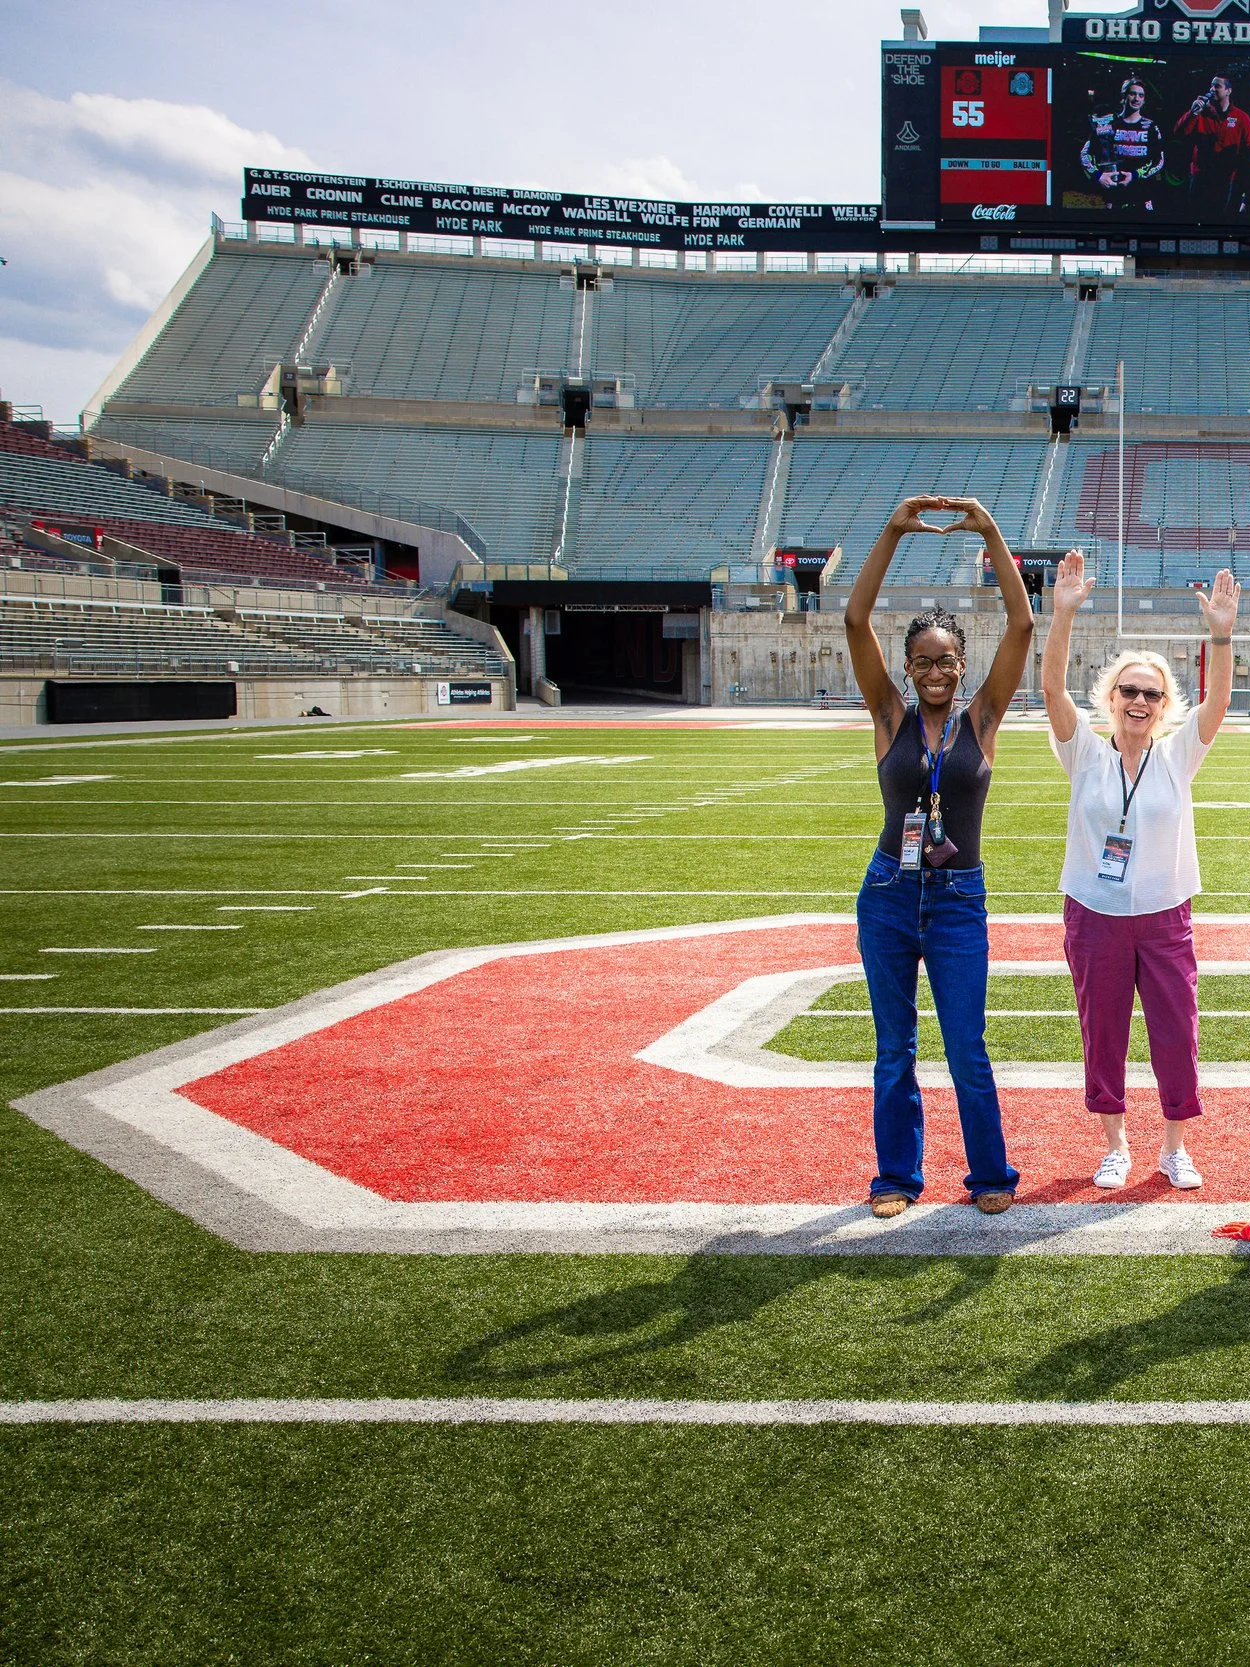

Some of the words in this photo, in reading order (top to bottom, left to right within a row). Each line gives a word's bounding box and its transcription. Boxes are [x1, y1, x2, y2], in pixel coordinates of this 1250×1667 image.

[1085, 18, 1161, 42] OHIO
[884, 53, 932, 66] DEFEND
[974, 51, 1017, 67] meijer
[896, 64, 920, 75] THE
[890, 74, 925, 85] 'SHOE
[952, 101, 984, 127] 55
[948, 160, 969, 168] DOWN
[981, 160, 989, 168] TO
[1013, 161, 1029, 169] BALL
[250, 169, 262, 178] G.
[263, 171, 271, 179] &
[272, 172, 282, 180] T.
[283, 172, 367, 187] SCHOTTENSTEIN
[250, 183, 292, 198] AUER
[306, 188, 363, 204] CRONIN
[473, 186, 509, 198] DESHE,
[513, 190, 562, 202] DIAMOND
[380, 194, 424, 208] CLINE
[432, 198, 494, 214] BACOME
[584, 197, 610, 210] LES
[614, 198, 677, 216] WEXNER
[267, 206, 292, 217] HYDE
[294, 208, 318, 219] PARK
[321, 211, 349, 222] PRIME
[351, 212, 411, 226] STEAKHOUSE
[503, 203, 550, 217] McCOY
[562, 207, 632, 223] WANDELL
[693, 205, 751, 217] HARMON
[768, 205, 822, 217] COVELLI
[832, 206, 878, 218] WELLS
[436, 217, 469, 231] HYDE
[472, 219, 503, 233] PARK
[641, 213, 689, 227] WOLFE
[692, 216, 720, 228] FDN
[738, 218, 801, 229] GERMAIN
[528, 225, 552, 235] HYDE
[554, 227, 576, 237] PARK
[578, 229, 604, 239] PRIME
[606, 230, 661, 243] STEAKHOUSE
[684, 234, 714, 246] HYDE
[717, 234, 745, 246] PARK
[1061, 389, 1076, 403] 22
[63, 533, 92, 543] TOYOTA
